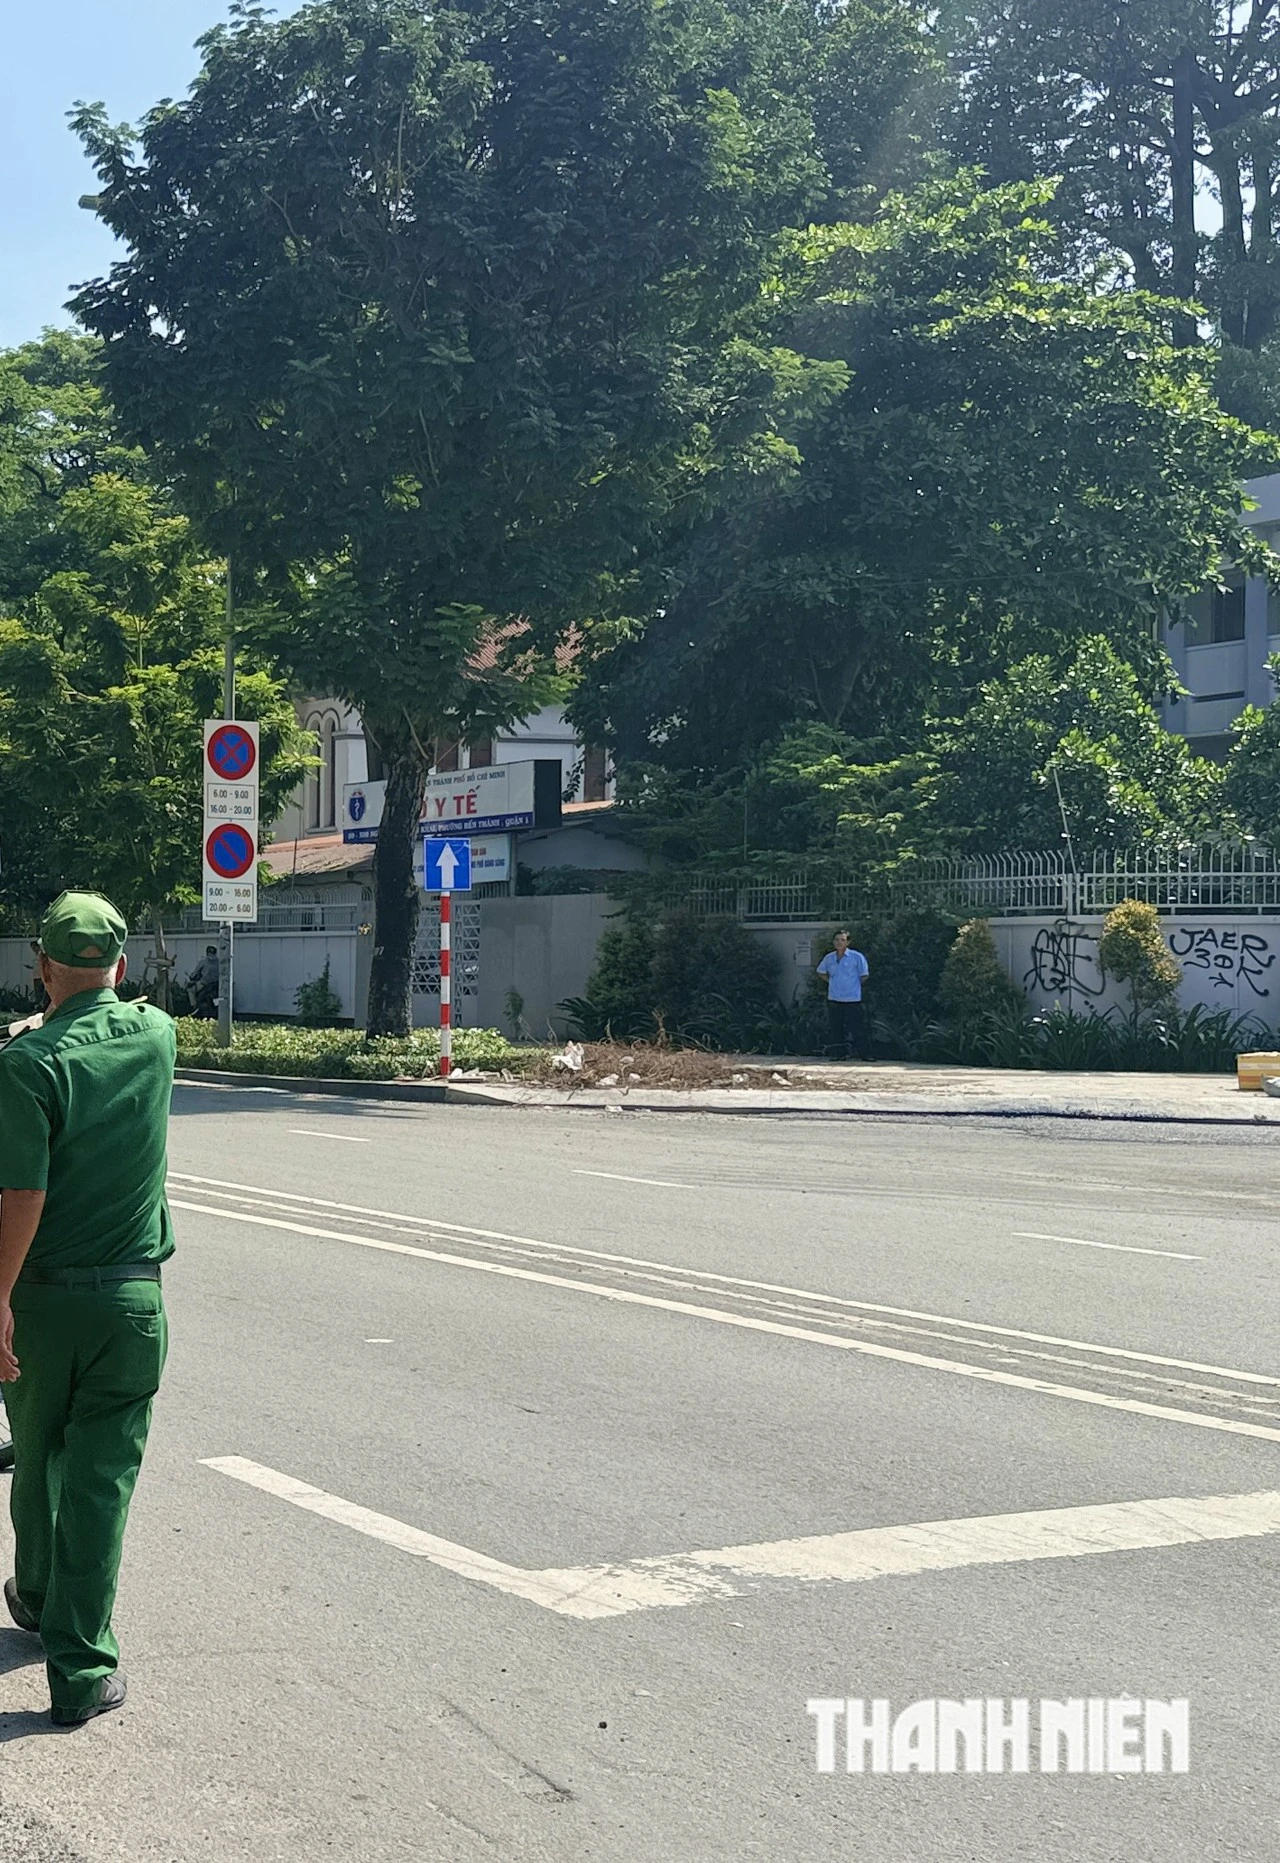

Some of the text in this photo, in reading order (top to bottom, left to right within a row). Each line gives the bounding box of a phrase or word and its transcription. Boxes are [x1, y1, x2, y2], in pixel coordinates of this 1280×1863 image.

[489, 771, 506, 780] MINH
[213, 789, 228, 798] 6.00
[234, 790, 249, 799] 9.00
[435, 797, 446, 817] Y
[453, 785, 480, 816] TẾ
[210, 804, 227, 813] 16.00
[233, 805, 252, 815] 20.00
[209, 887, 223, 896] 9.00
[234, 888, 251, 897] 16.00
[209, 902, 227, 912] 20.00
[236, 903, 251, 913] 6.00
